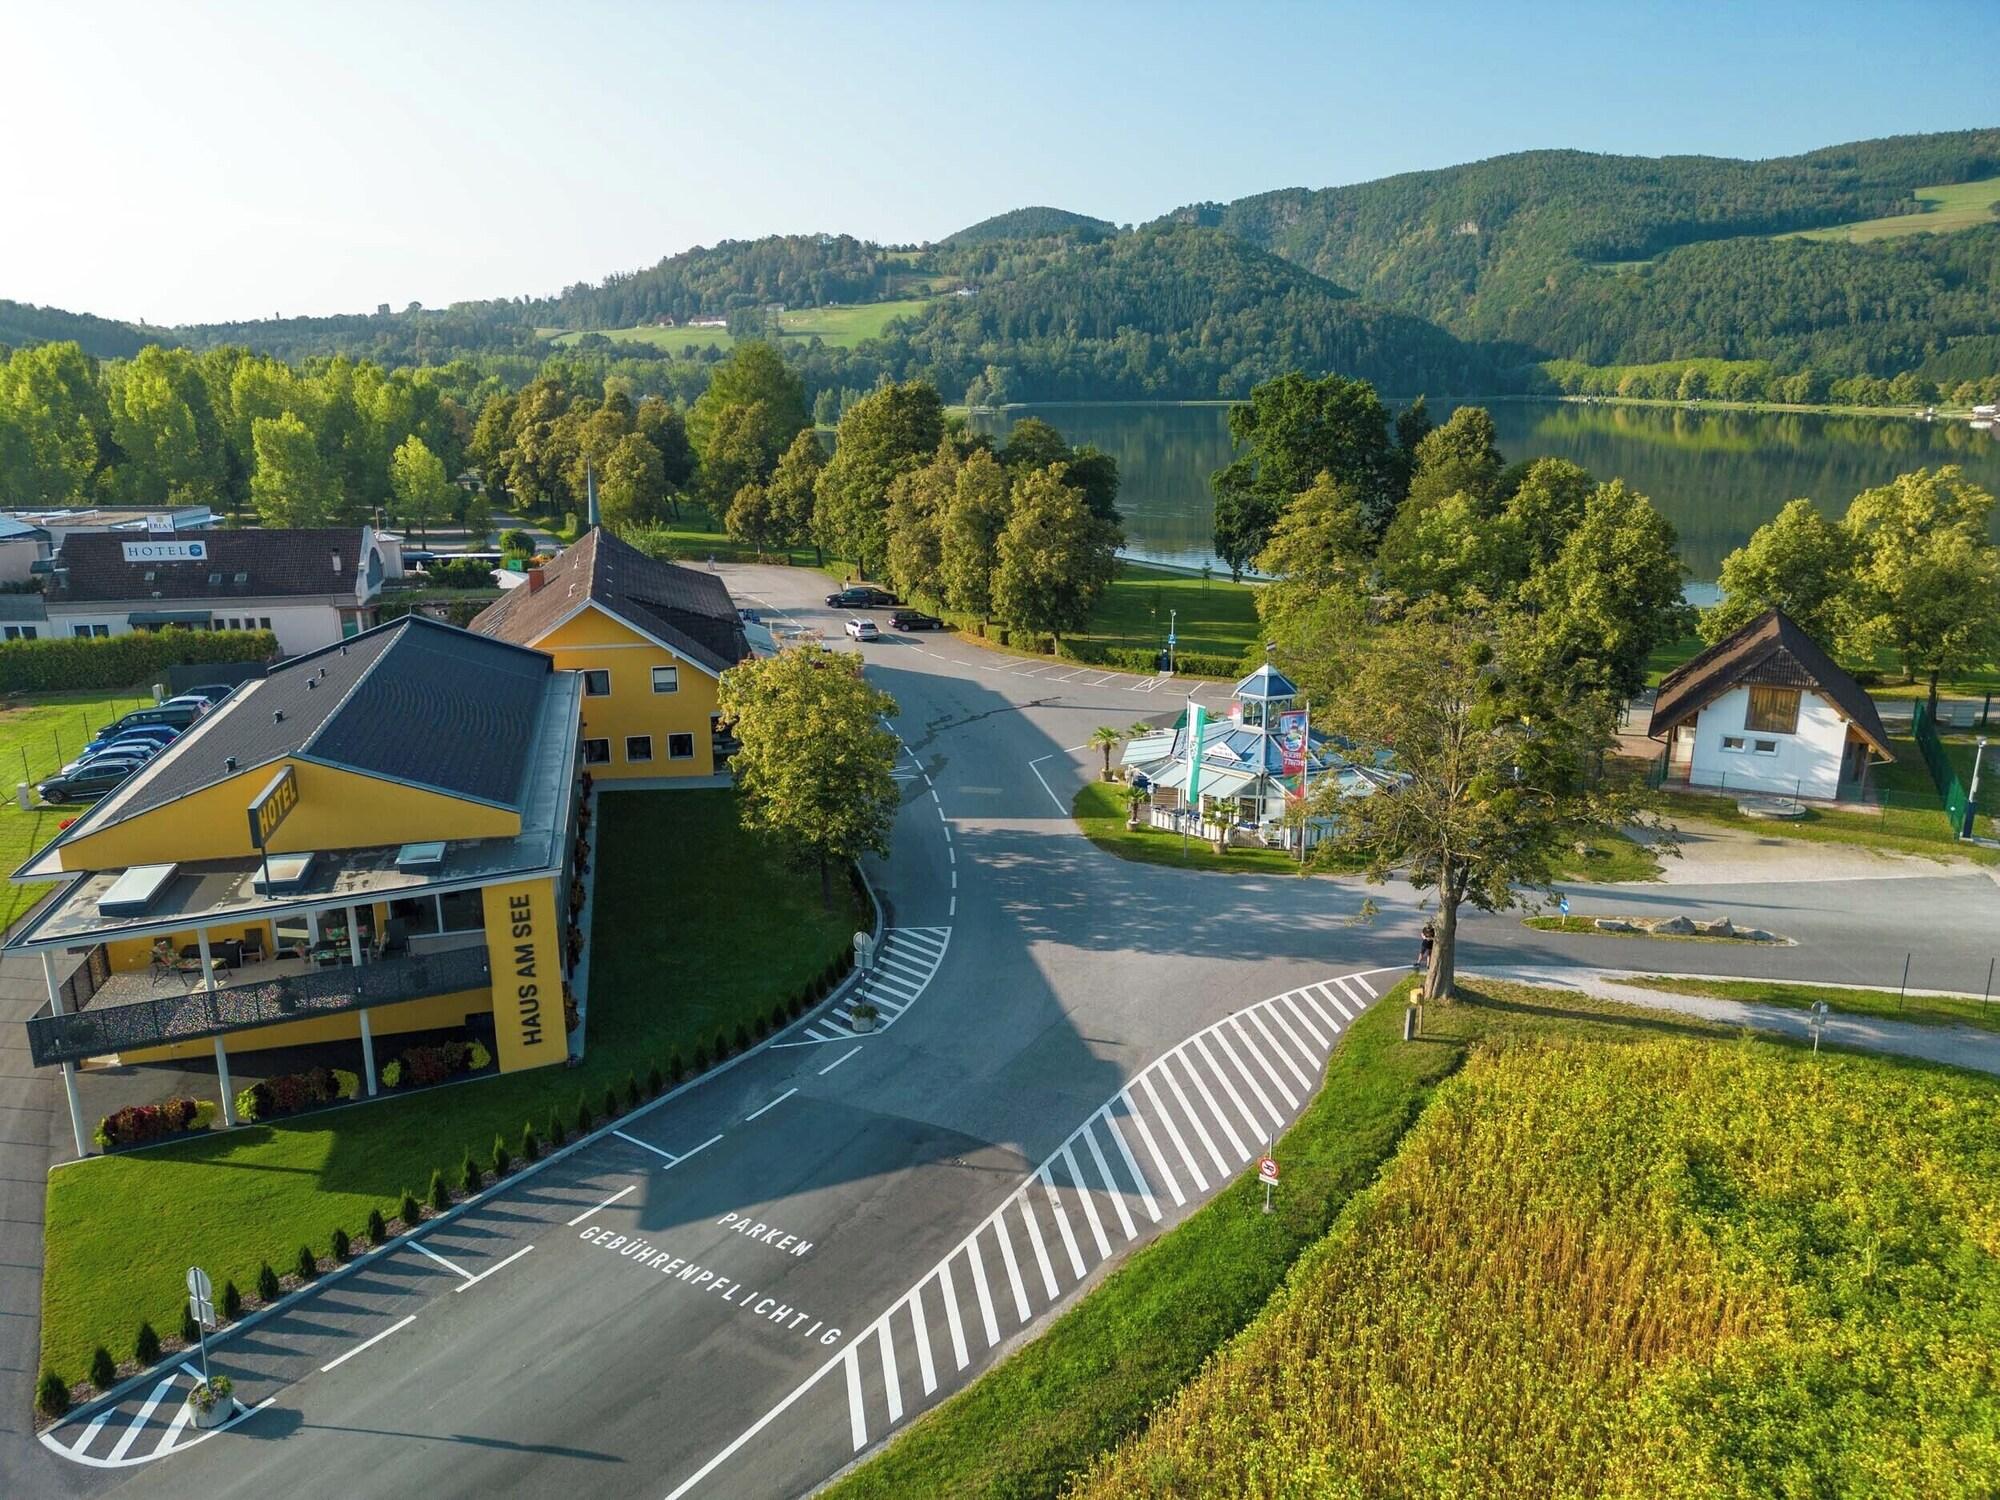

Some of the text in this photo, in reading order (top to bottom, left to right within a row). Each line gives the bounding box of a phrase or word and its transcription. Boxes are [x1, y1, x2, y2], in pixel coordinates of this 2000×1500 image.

[128, 546, 187, 556] HOTEL
[259, 776, 297, 839] HOTEL
[509, 894, 542, 1046] HAUS AM SEE
[717, 1212, 813, 1257] PARKEN
[579, 1226, 842, 1345] GEBÜHRENPFLICHTIG
